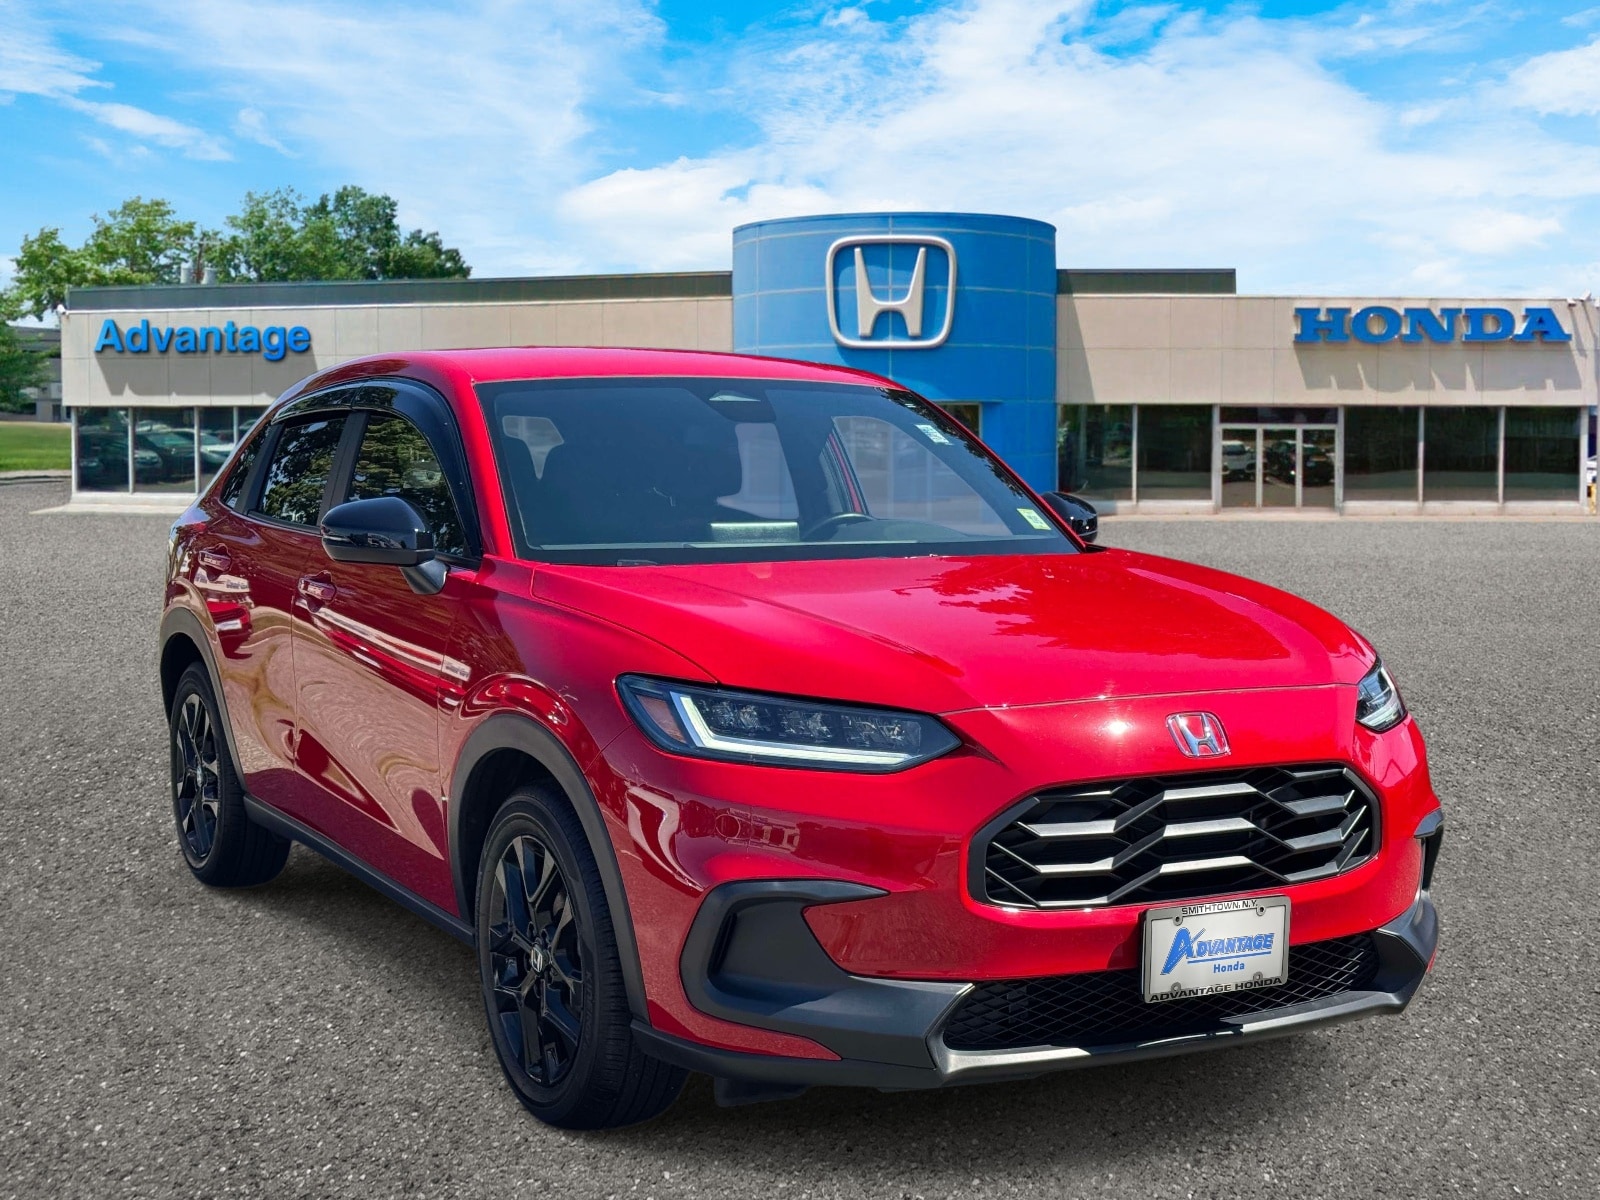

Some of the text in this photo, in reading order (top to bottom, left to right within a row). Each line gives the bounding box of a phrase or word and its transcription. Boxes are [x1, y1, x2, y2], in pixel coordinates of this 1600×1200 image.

[94, 318, 312, 361] Advantage
[1294, 306, 1572, 343] HONDA
[1160, 926, 1275, 975] ADVANTAGE
[1213, 961, 1245, 974] Honda
[1150, 977, 1282, 1002] ADVANTAGE HONDA
